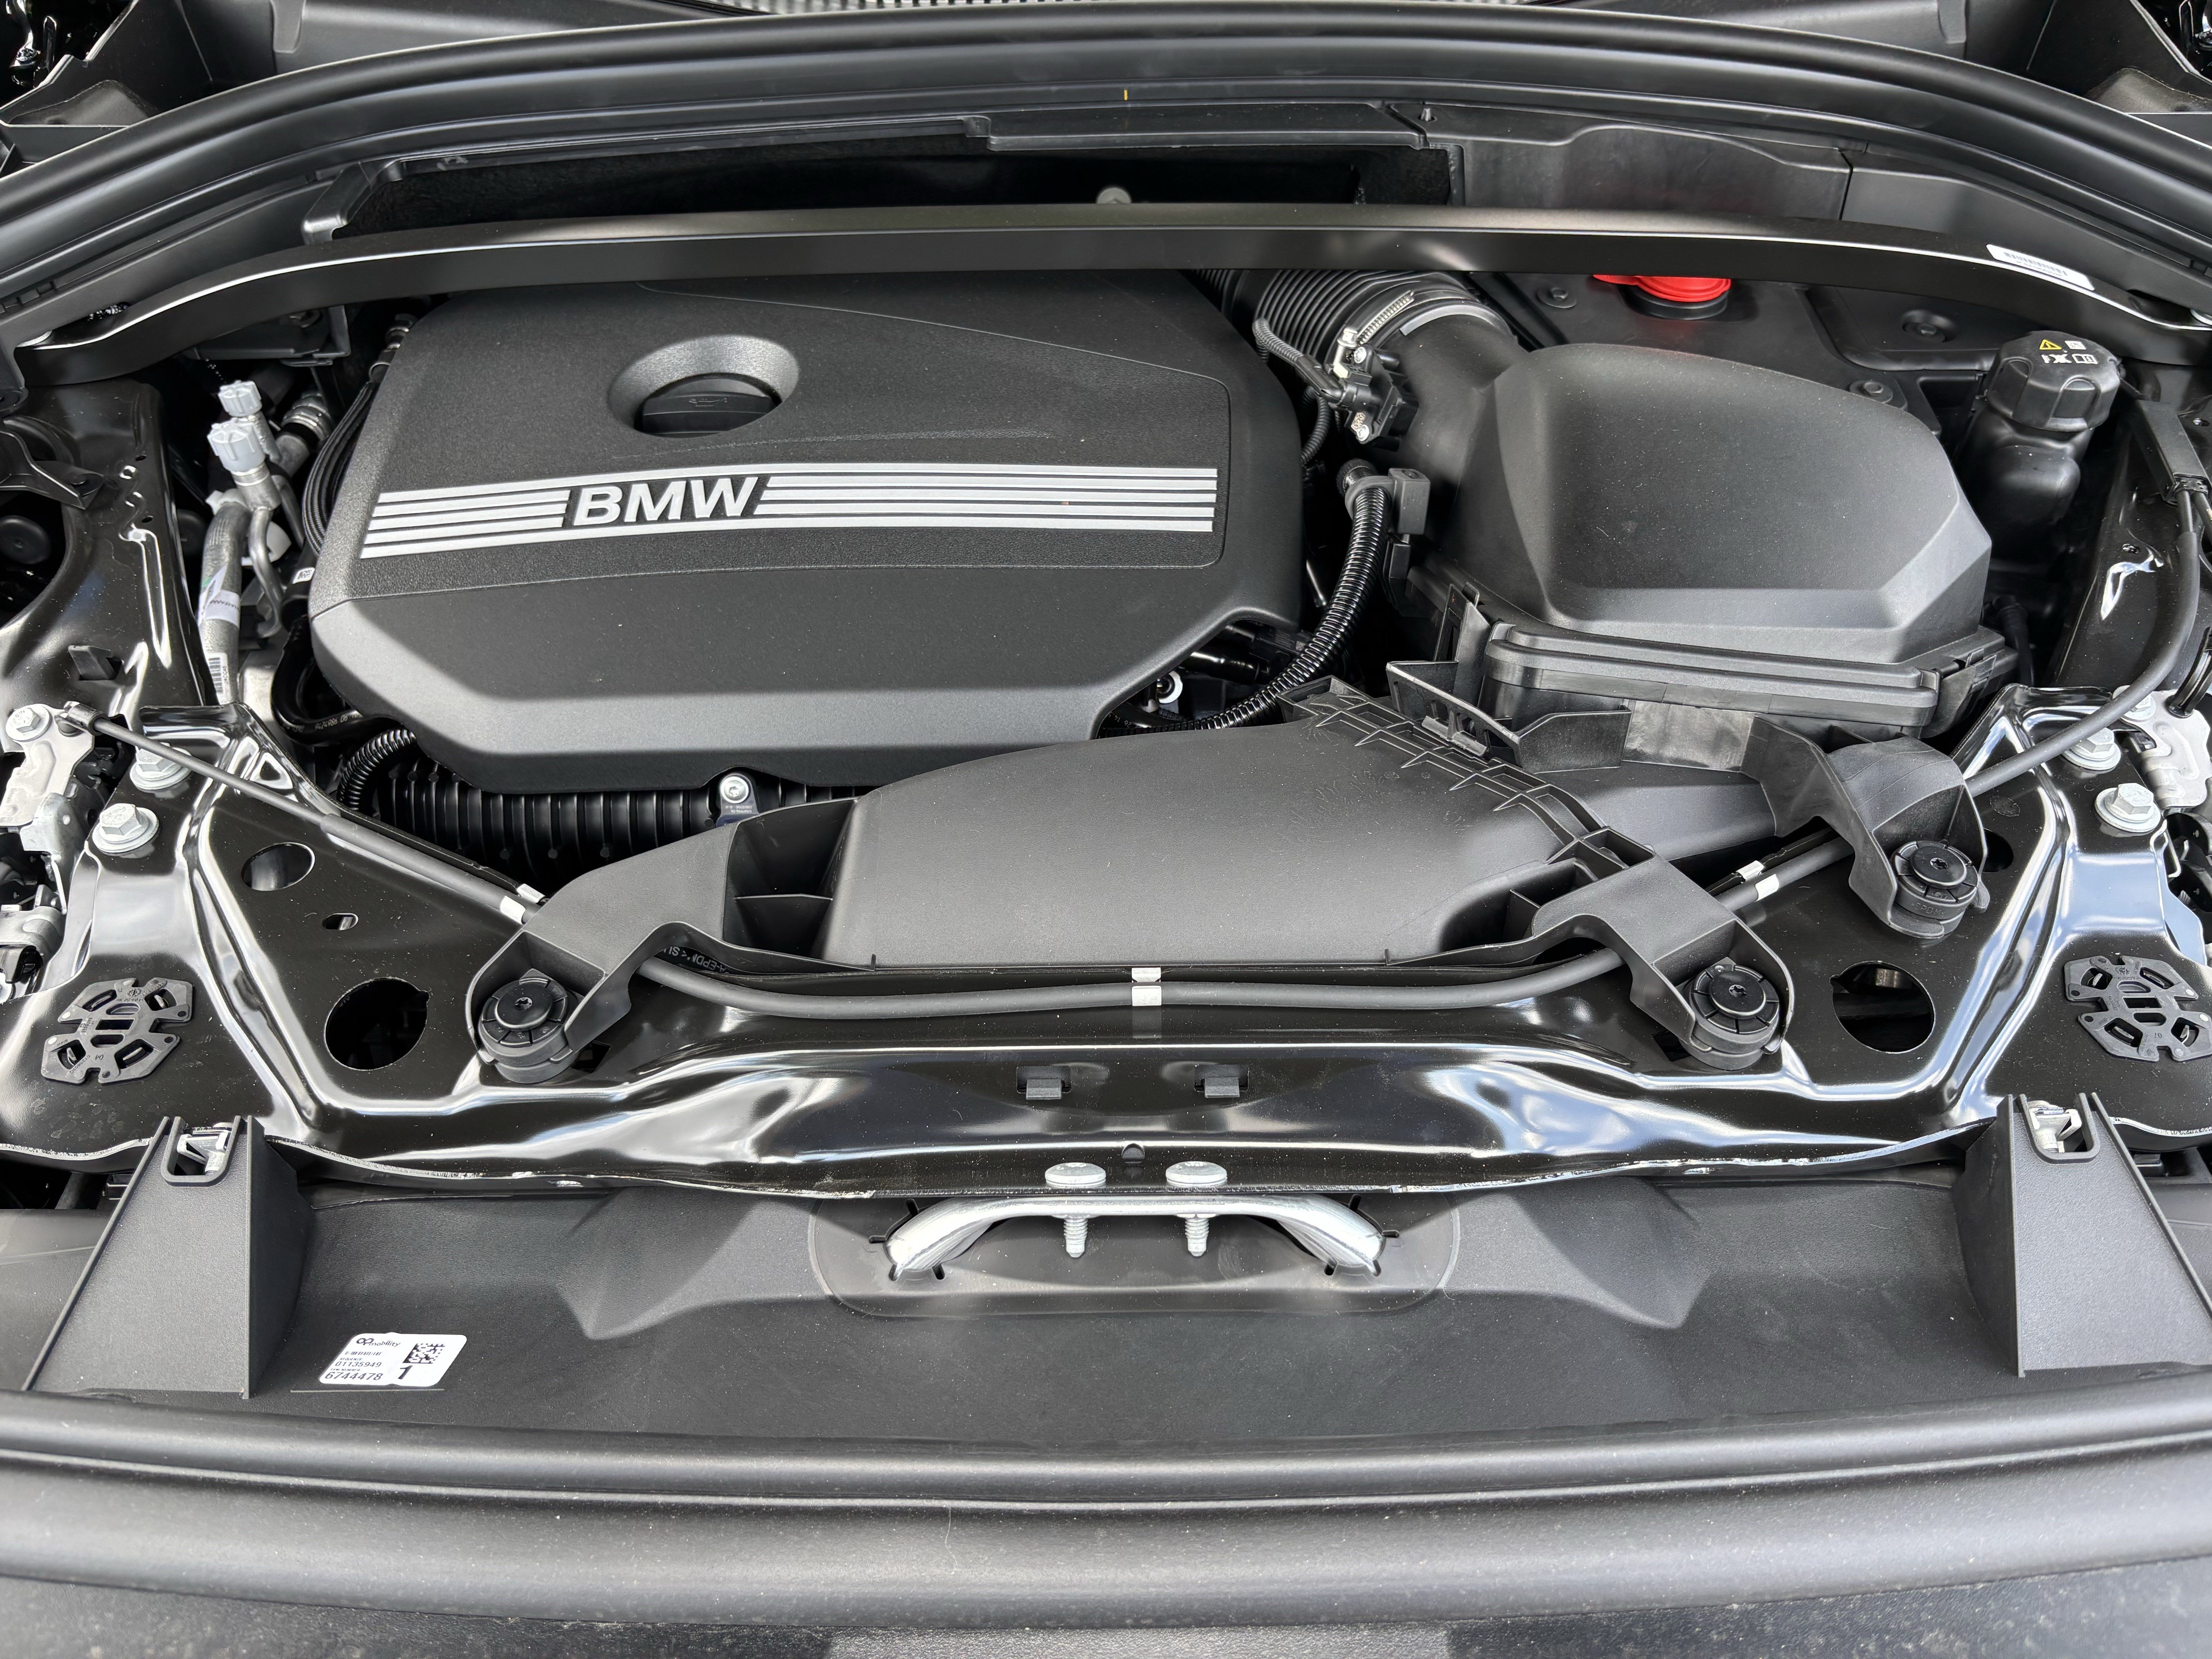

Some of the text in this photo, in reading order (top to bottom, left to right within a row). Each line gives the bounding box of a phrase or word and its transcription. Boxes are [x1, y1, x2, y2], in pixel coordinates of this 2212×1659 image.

[573, 477, 759, 526] BMW
[325, 1371, 383, 1381] 6744478
[397, 1365, 413, 1380] 1
